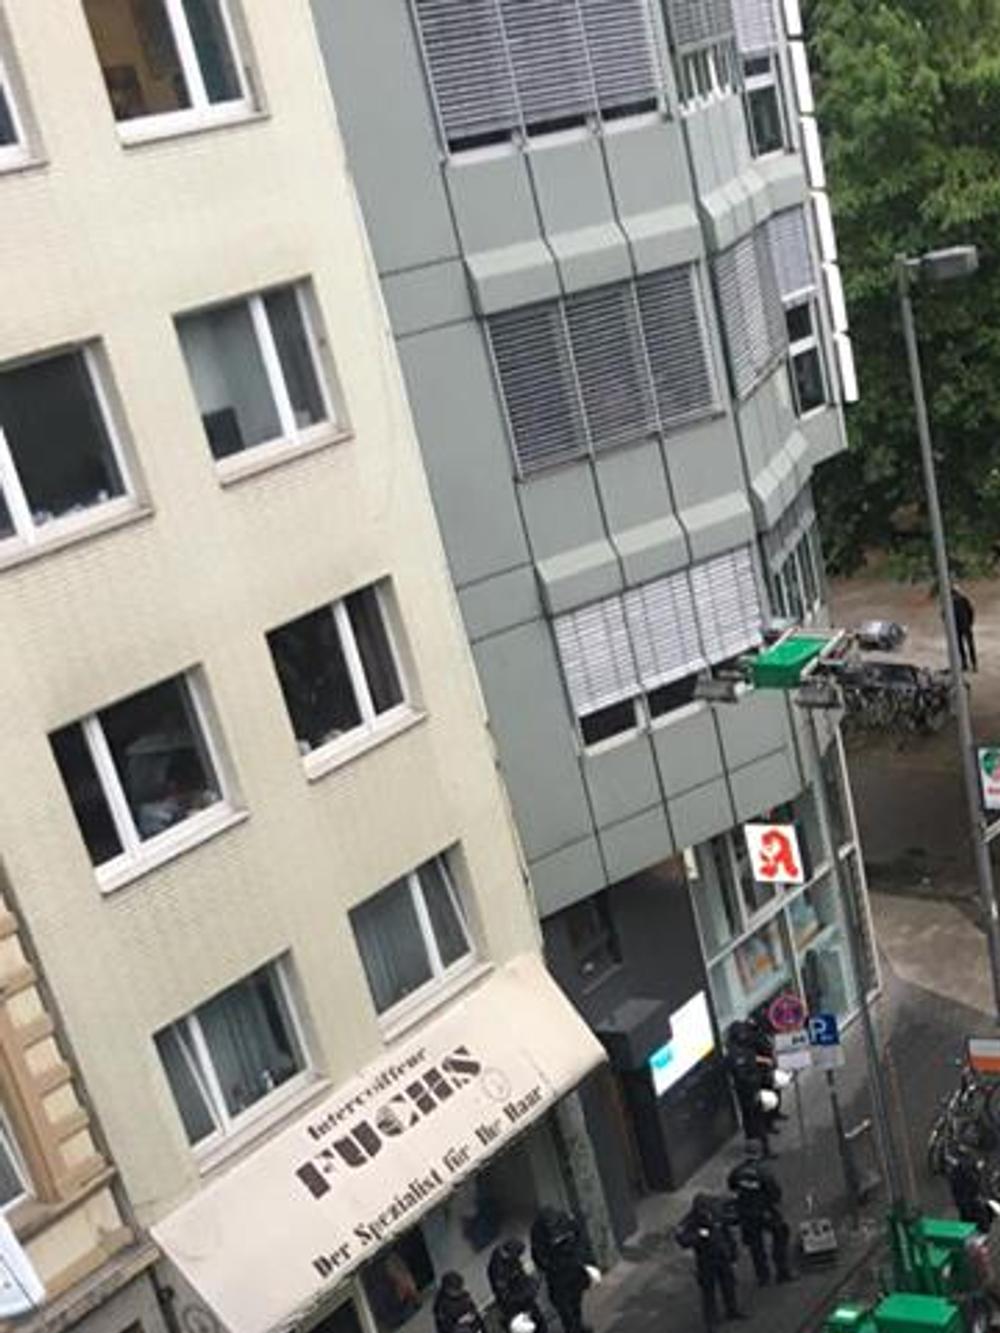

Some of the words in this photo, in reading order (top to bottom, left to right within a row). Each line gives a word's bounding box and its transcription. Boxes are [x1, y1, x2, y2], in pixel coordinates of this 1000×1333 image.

[295, 1045, 481, 1199] FUCHS
[307, 1048, 426, 1141] Intercoiffeur
[312, 1243, 350, 1279] Der
[353, 1169, 444, 1246] Spezialist
[442, 1145, 471, 1173] für
[474, 1119, 502, 1146] Ihr
[502, 1086, 544, 1123] Haar
